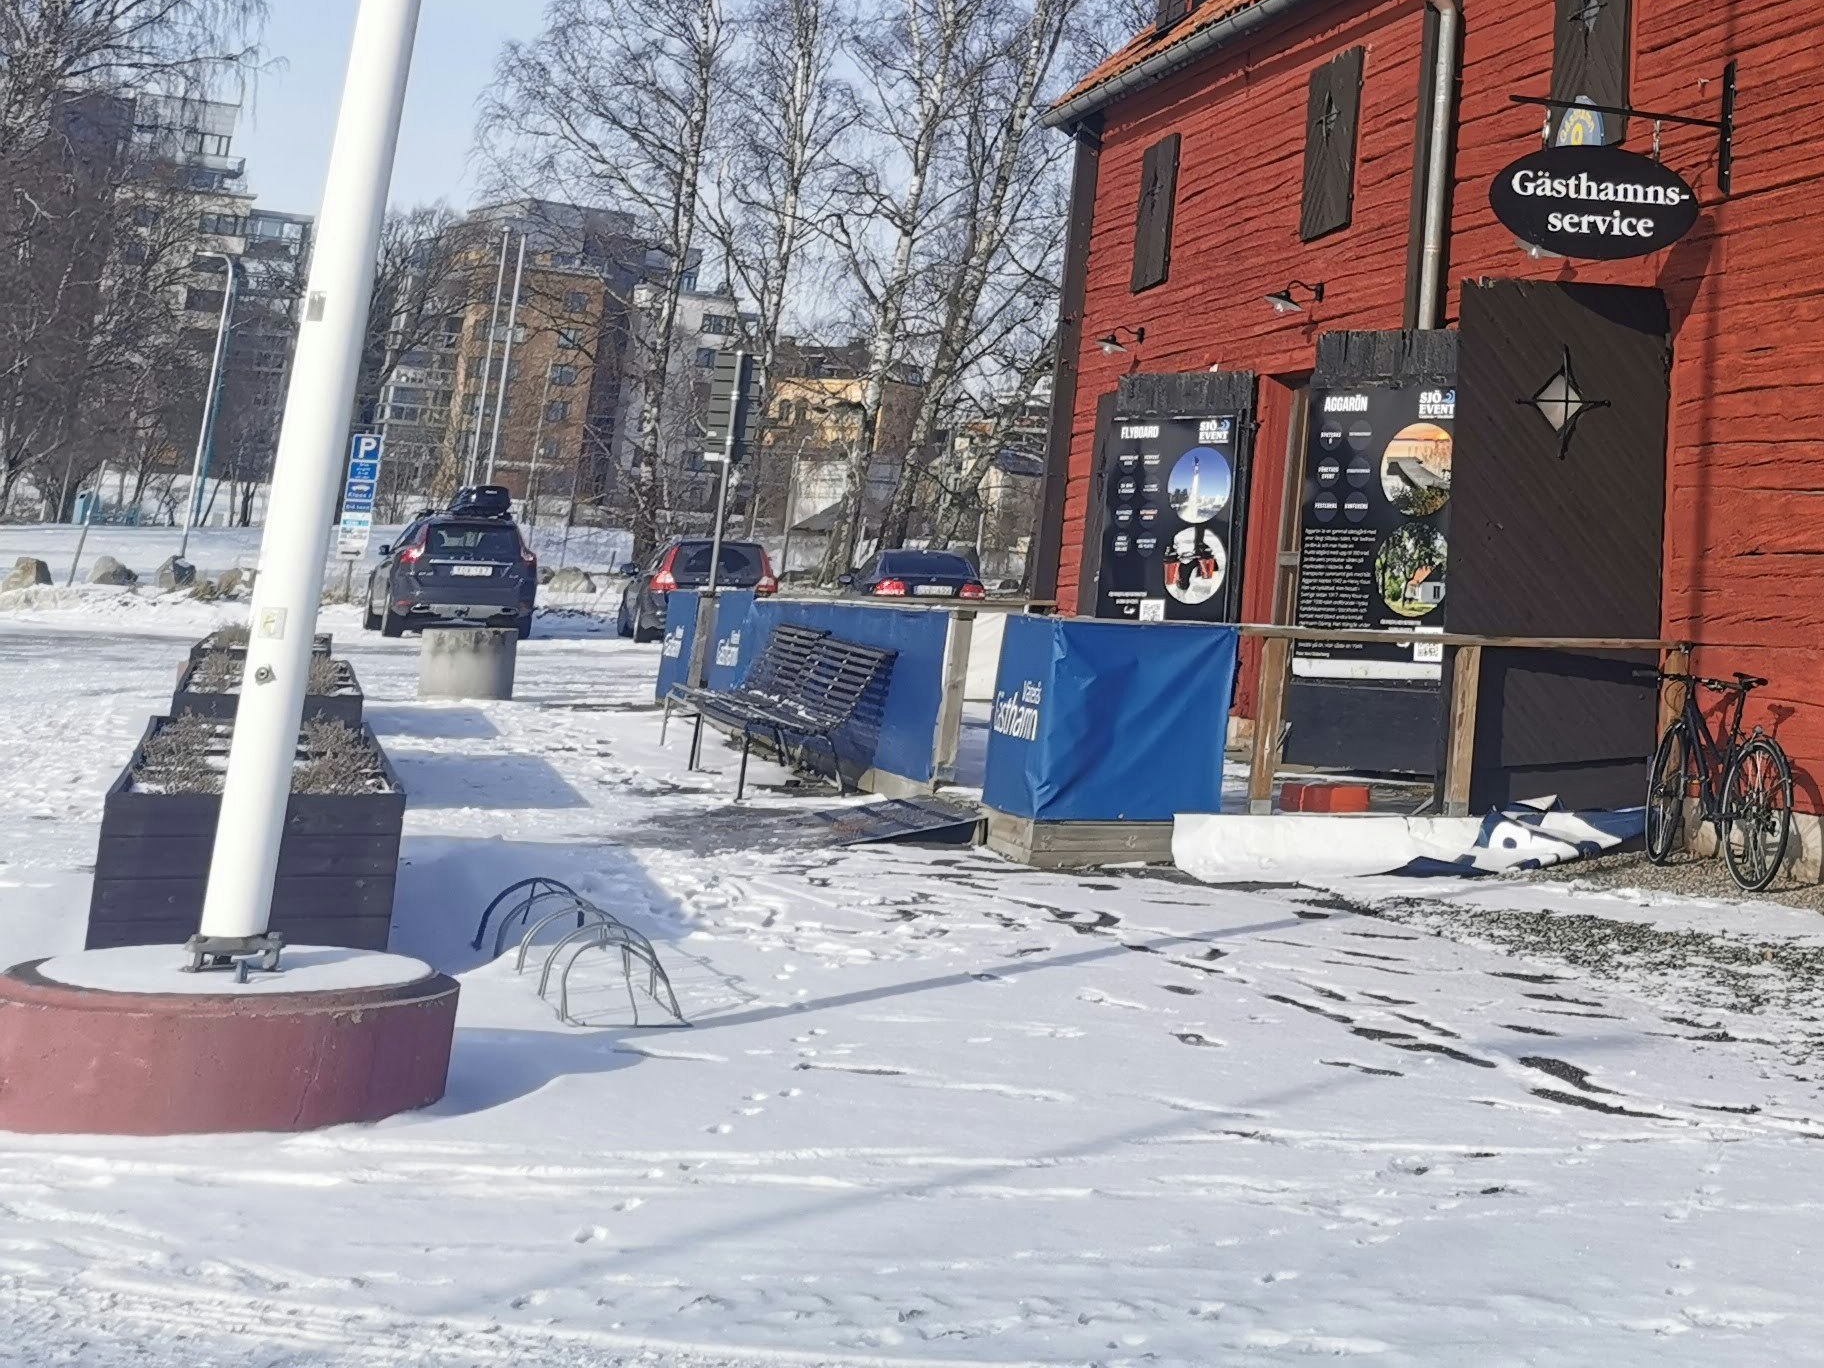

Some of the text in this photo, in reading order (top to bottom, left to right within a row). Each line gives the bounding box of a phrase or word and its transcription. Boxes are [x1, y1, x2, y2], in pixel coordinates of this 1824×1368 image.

[1511, 170, 1690, 206] Gästhamns-
[1547, 209, 1655, 238] service
[1324, 394, 1368, 412] AGGARÖN
[1419, 389, 1442, 404] SJÖ
[1418, 403, 1455, 415] EVENT
[1120, 425, 1160, 439] FLYBOARD
[1199, 419, 1218, 431] SJÖ
[1199, 431, 1229, 440] EVENT
[358, 437, 378, 459] P
